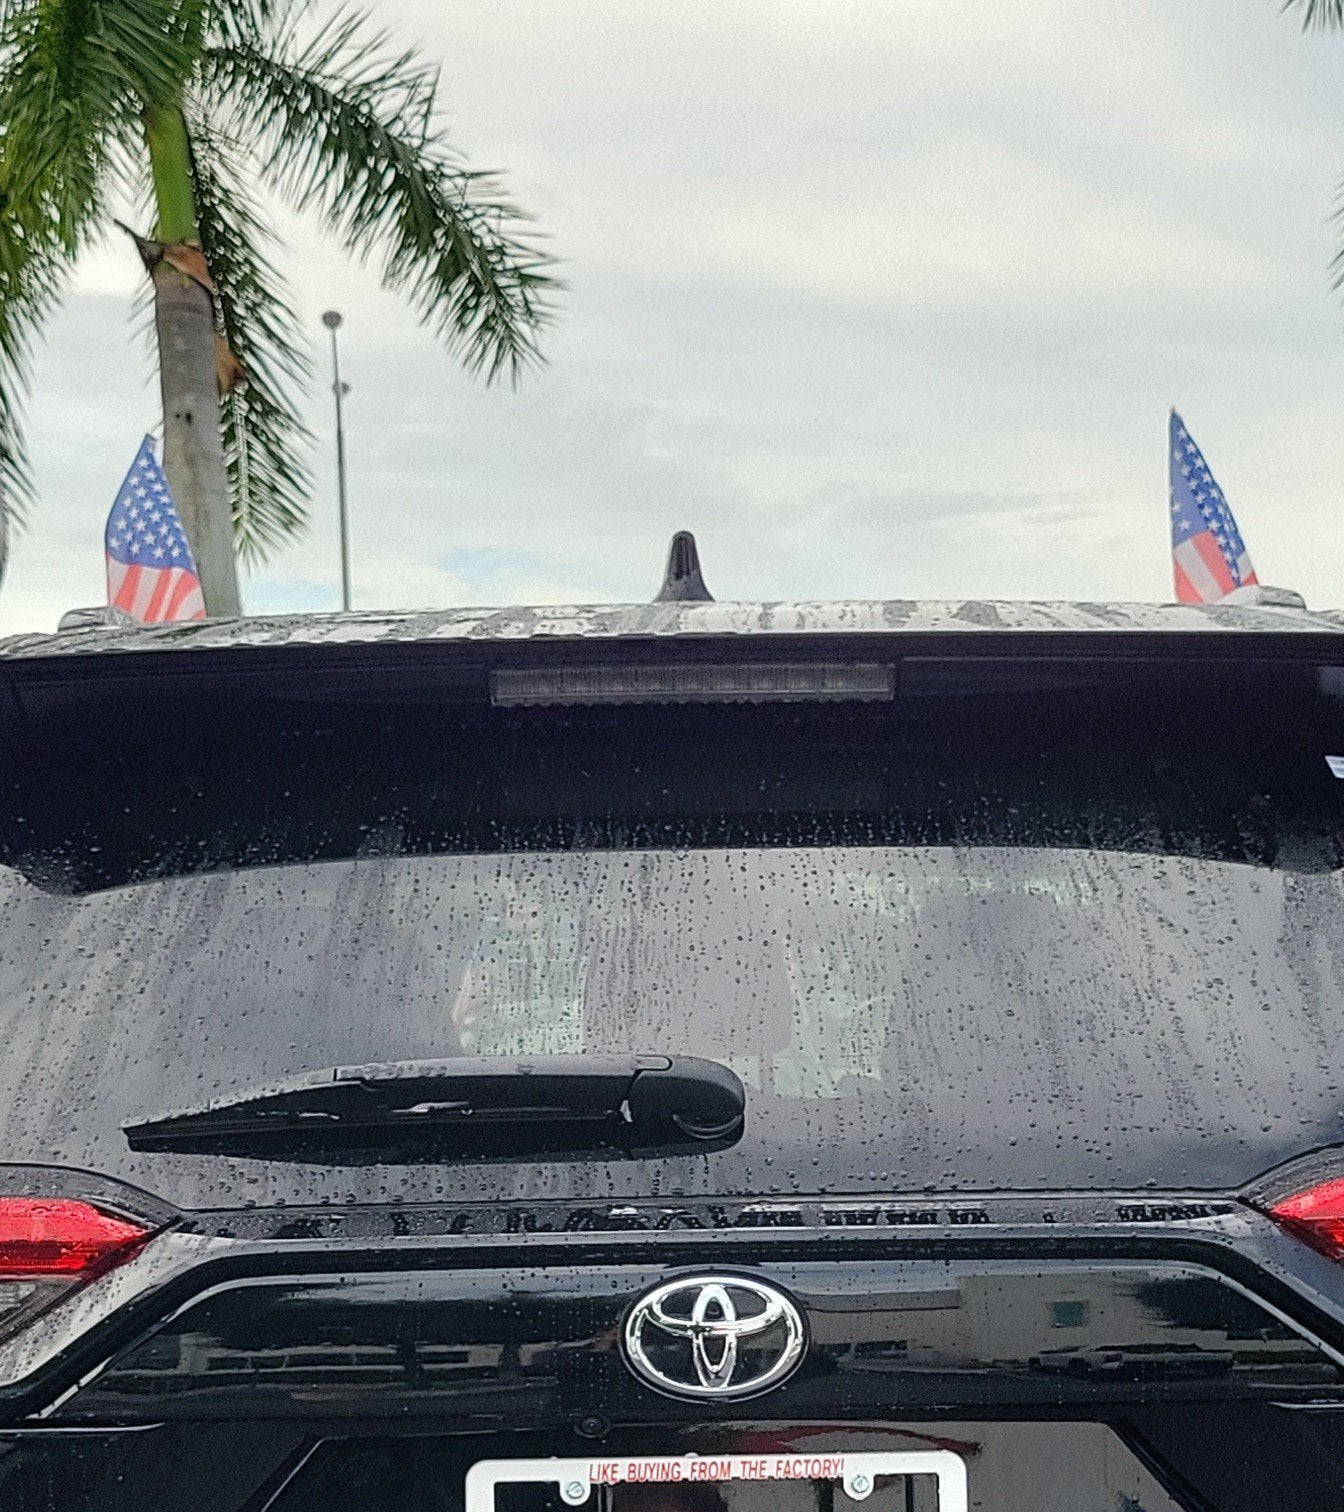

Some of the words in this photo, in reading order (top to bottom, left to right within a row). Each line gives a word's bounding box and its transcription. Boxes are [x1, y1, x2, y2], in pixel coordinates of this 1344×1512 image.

[589, 1463, 619, 1482] LIKE
[627, 1462, 682, 1481] BUYING
[690, 1461, 732, 1480] FROM
[740, 1460, 768, 1478] THE
[775, 1458, 845, 1478] FACTORY!
